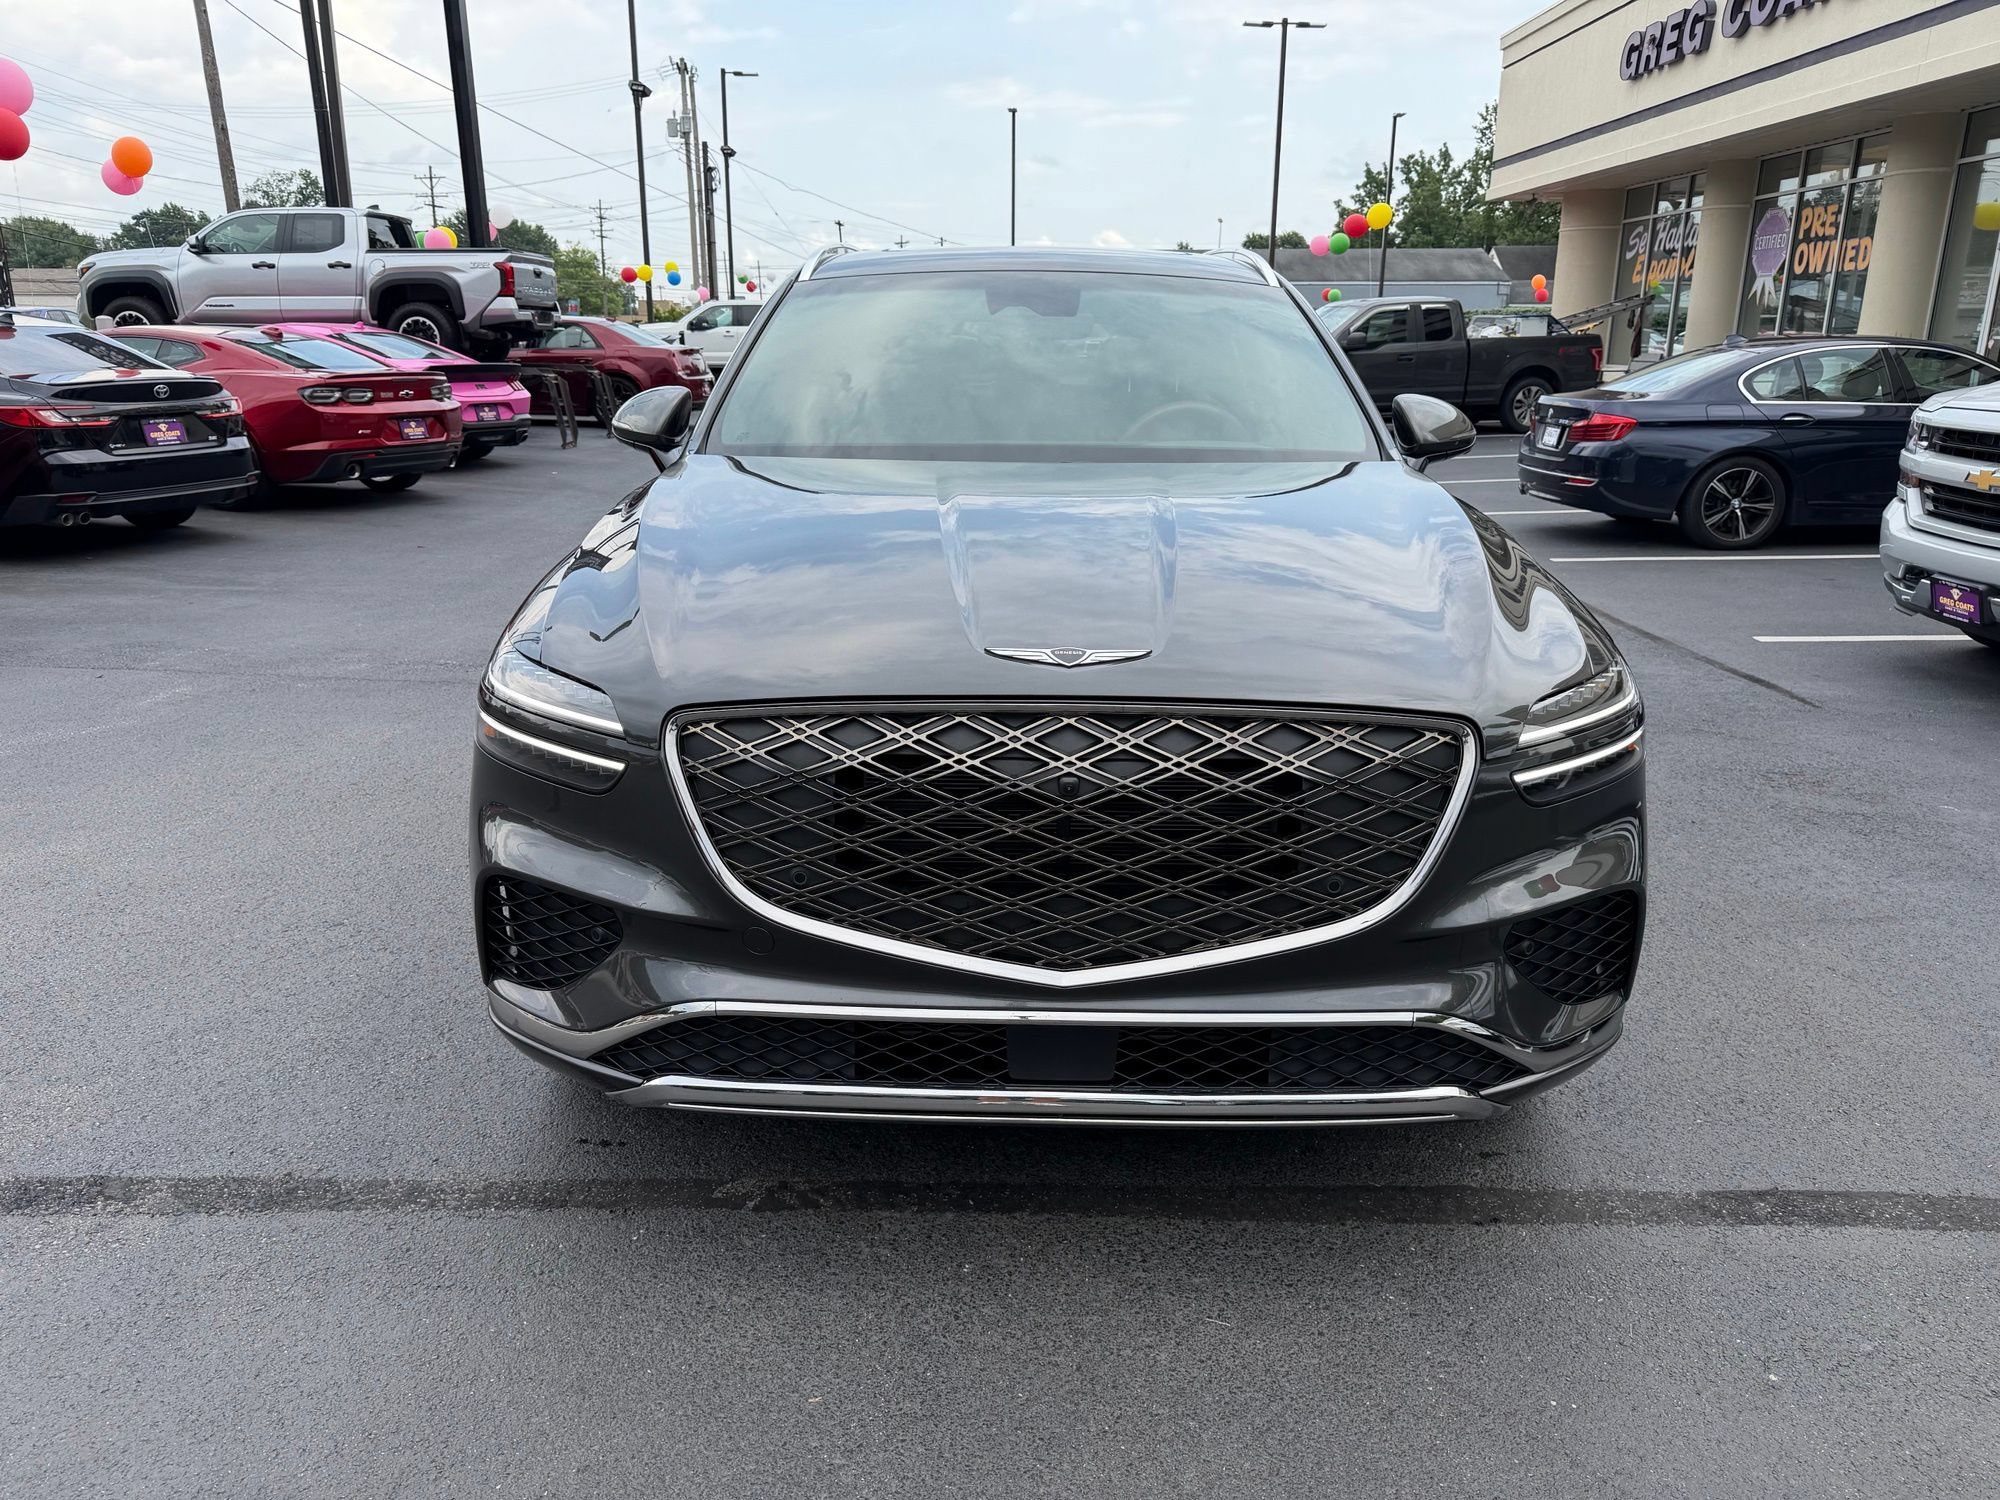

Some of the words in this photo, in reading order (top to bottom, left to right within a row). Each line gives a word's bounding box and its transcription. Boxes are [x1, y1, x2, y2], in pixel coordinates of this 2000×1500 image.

[1620, 0, 1714, 81] GREG
[1625, 225, 1648, 260] Se
[1755, 233, 1787, 251] CERTIFIED
[1794, 236, 1872, 275] OWNED
[1955, 600, 1975, 612] COATS
